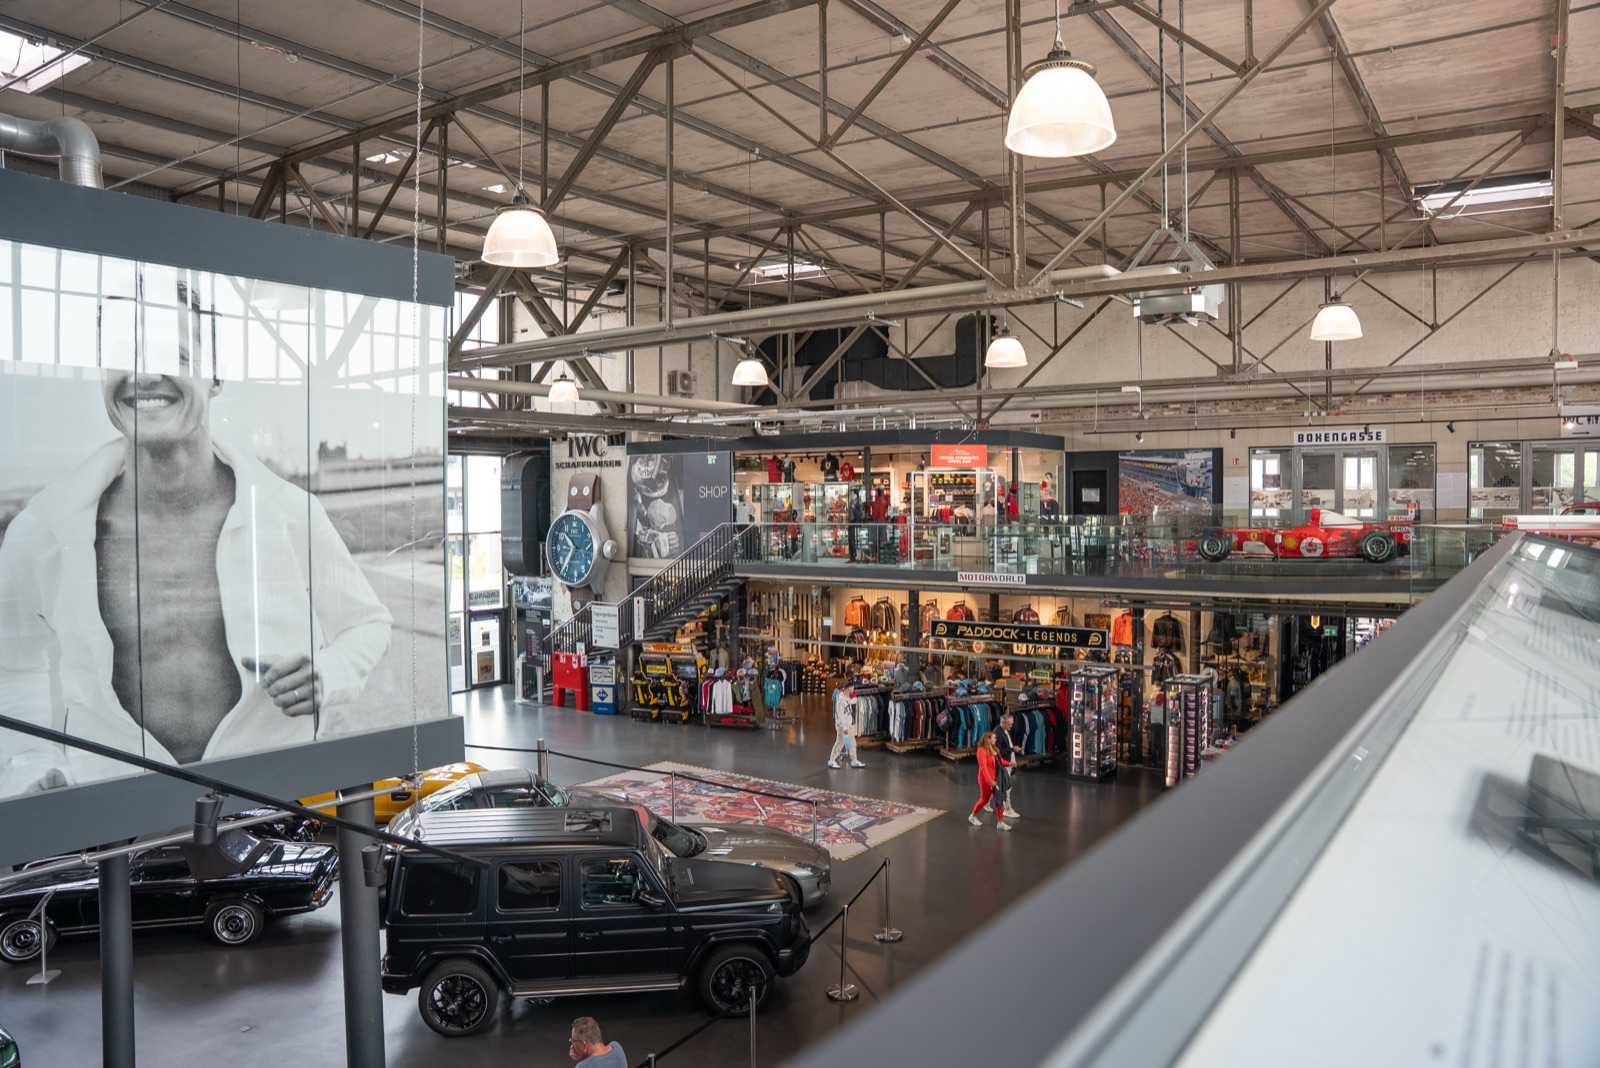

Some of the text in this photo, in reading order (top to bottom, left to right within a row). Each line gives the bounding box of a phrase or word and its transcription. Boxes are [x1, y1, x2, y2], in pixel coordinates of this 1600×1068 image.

[1297, 431, 1382, 443] BOXENGASSE
[568, 435, 606, 458] IWC
[555, 460, 621, 470] SCHAFFHAUSEN
[698, 485, 728, 499] SHOP
[959, 573, 1024, 583] MOTORWORLD
